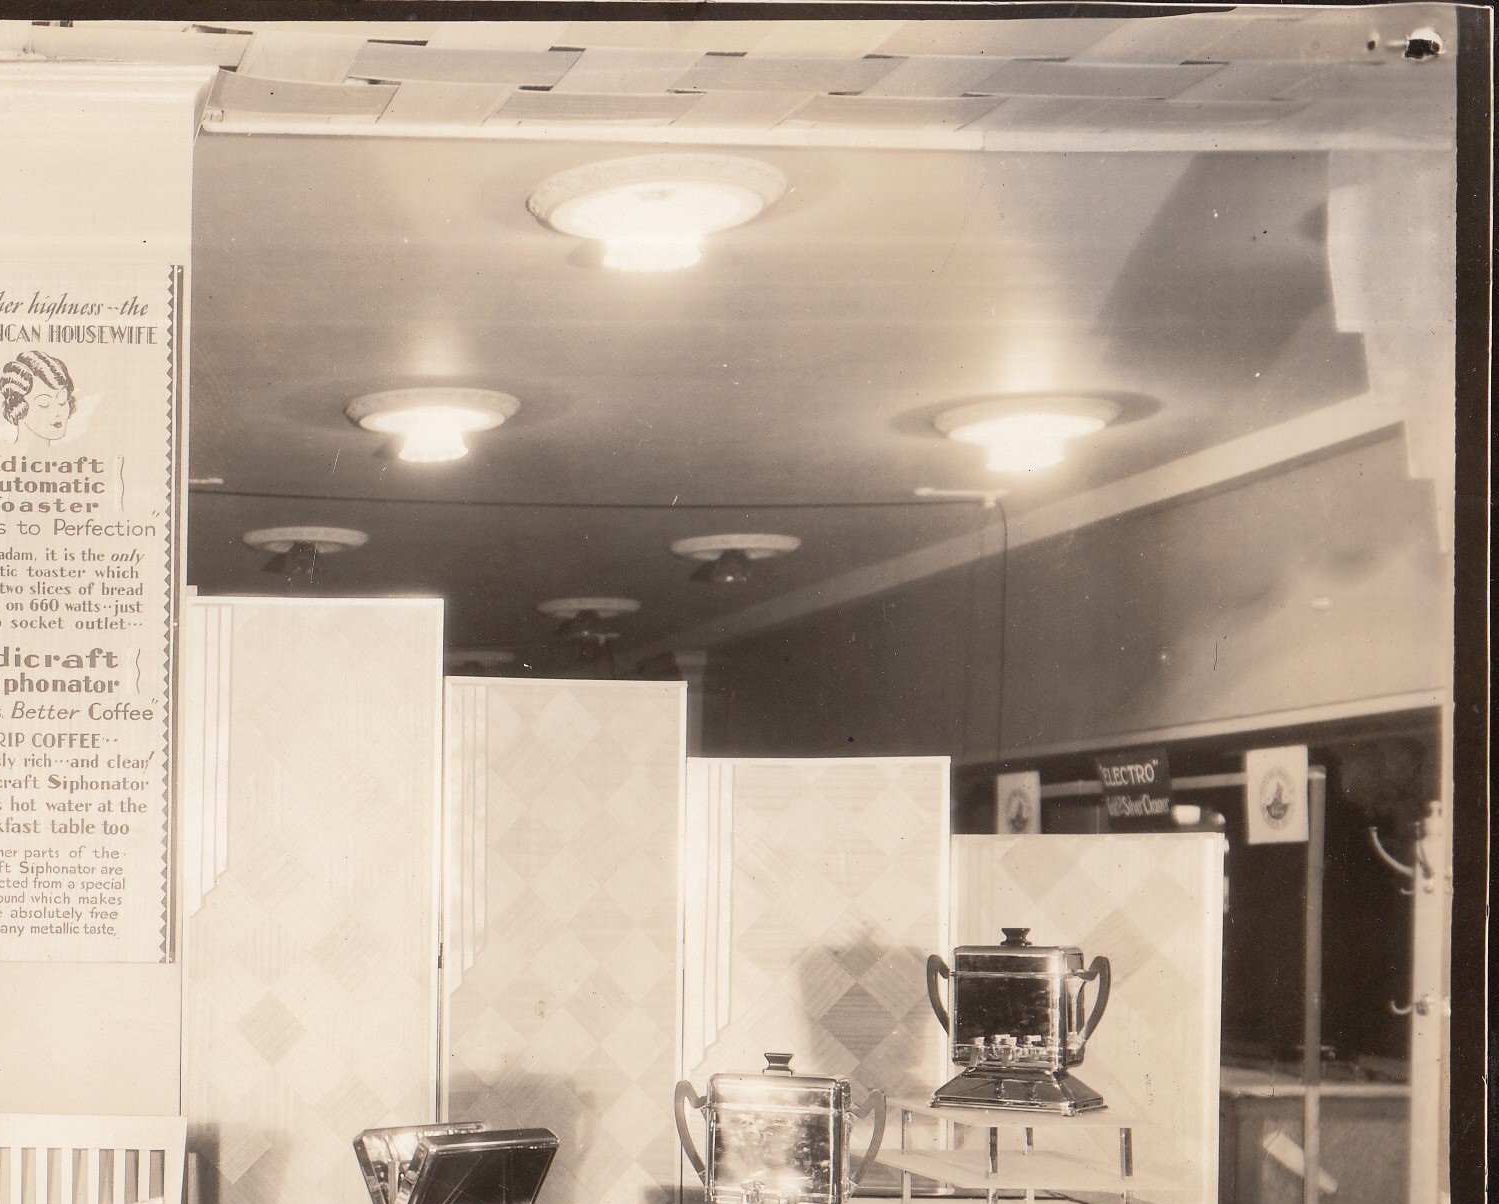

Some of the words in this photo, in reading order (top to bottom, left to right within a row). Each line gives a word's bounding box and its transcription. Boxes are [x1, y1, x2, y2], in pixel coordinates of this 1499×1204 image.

[49, 324, 158, 345] HOUSEWIFE
[17, 519, 41, 536] to
[45, 547, 57, 561] it
[64, 549, 75, 561] is
[81, 548, 105, 562] the
[110, 548, 145, 566] only
[26, 566, 86, 578] toaster
[95, 566, 139, 579] which
[0, 582, 24, 595] two
[29, 581, 71, 595] slices
[78, 582, 95, 595] of
[101, 581, 144, 596] bread
[6, 602, 24, 612] on
[29, 599, 60, 612] 660
[11, 616, 65, 629] socket
[11, 700, 81, 720] Better
[47, 774, 149, 794] Siphonator
[11, 797, 37, 812] hot
[46, 799, 92, 812] water
[98, 800, 114, 813] at
[120, 799, 148, 814] the
[50, 819, 96, 834] table
[103, 820, 130, 835] too
[24, 847, 60, 864] parts
[69, 846, 86, 859] of
[19, 861, 96, 881] Siphonator
[100, 865, 124, 875] are
[33, 877, 62, 889] from
[68, 880, 75, 889] a
[81, 878, 126, 893] special
[31, 892, 71, 905] which
[78, 892, 122, 907] makes
[10, 908, 83, 922] absolutely
[89, 908, 119, 920] free
[0, 924, 25, 938] any
[31, 924, 80, 935] metallic
